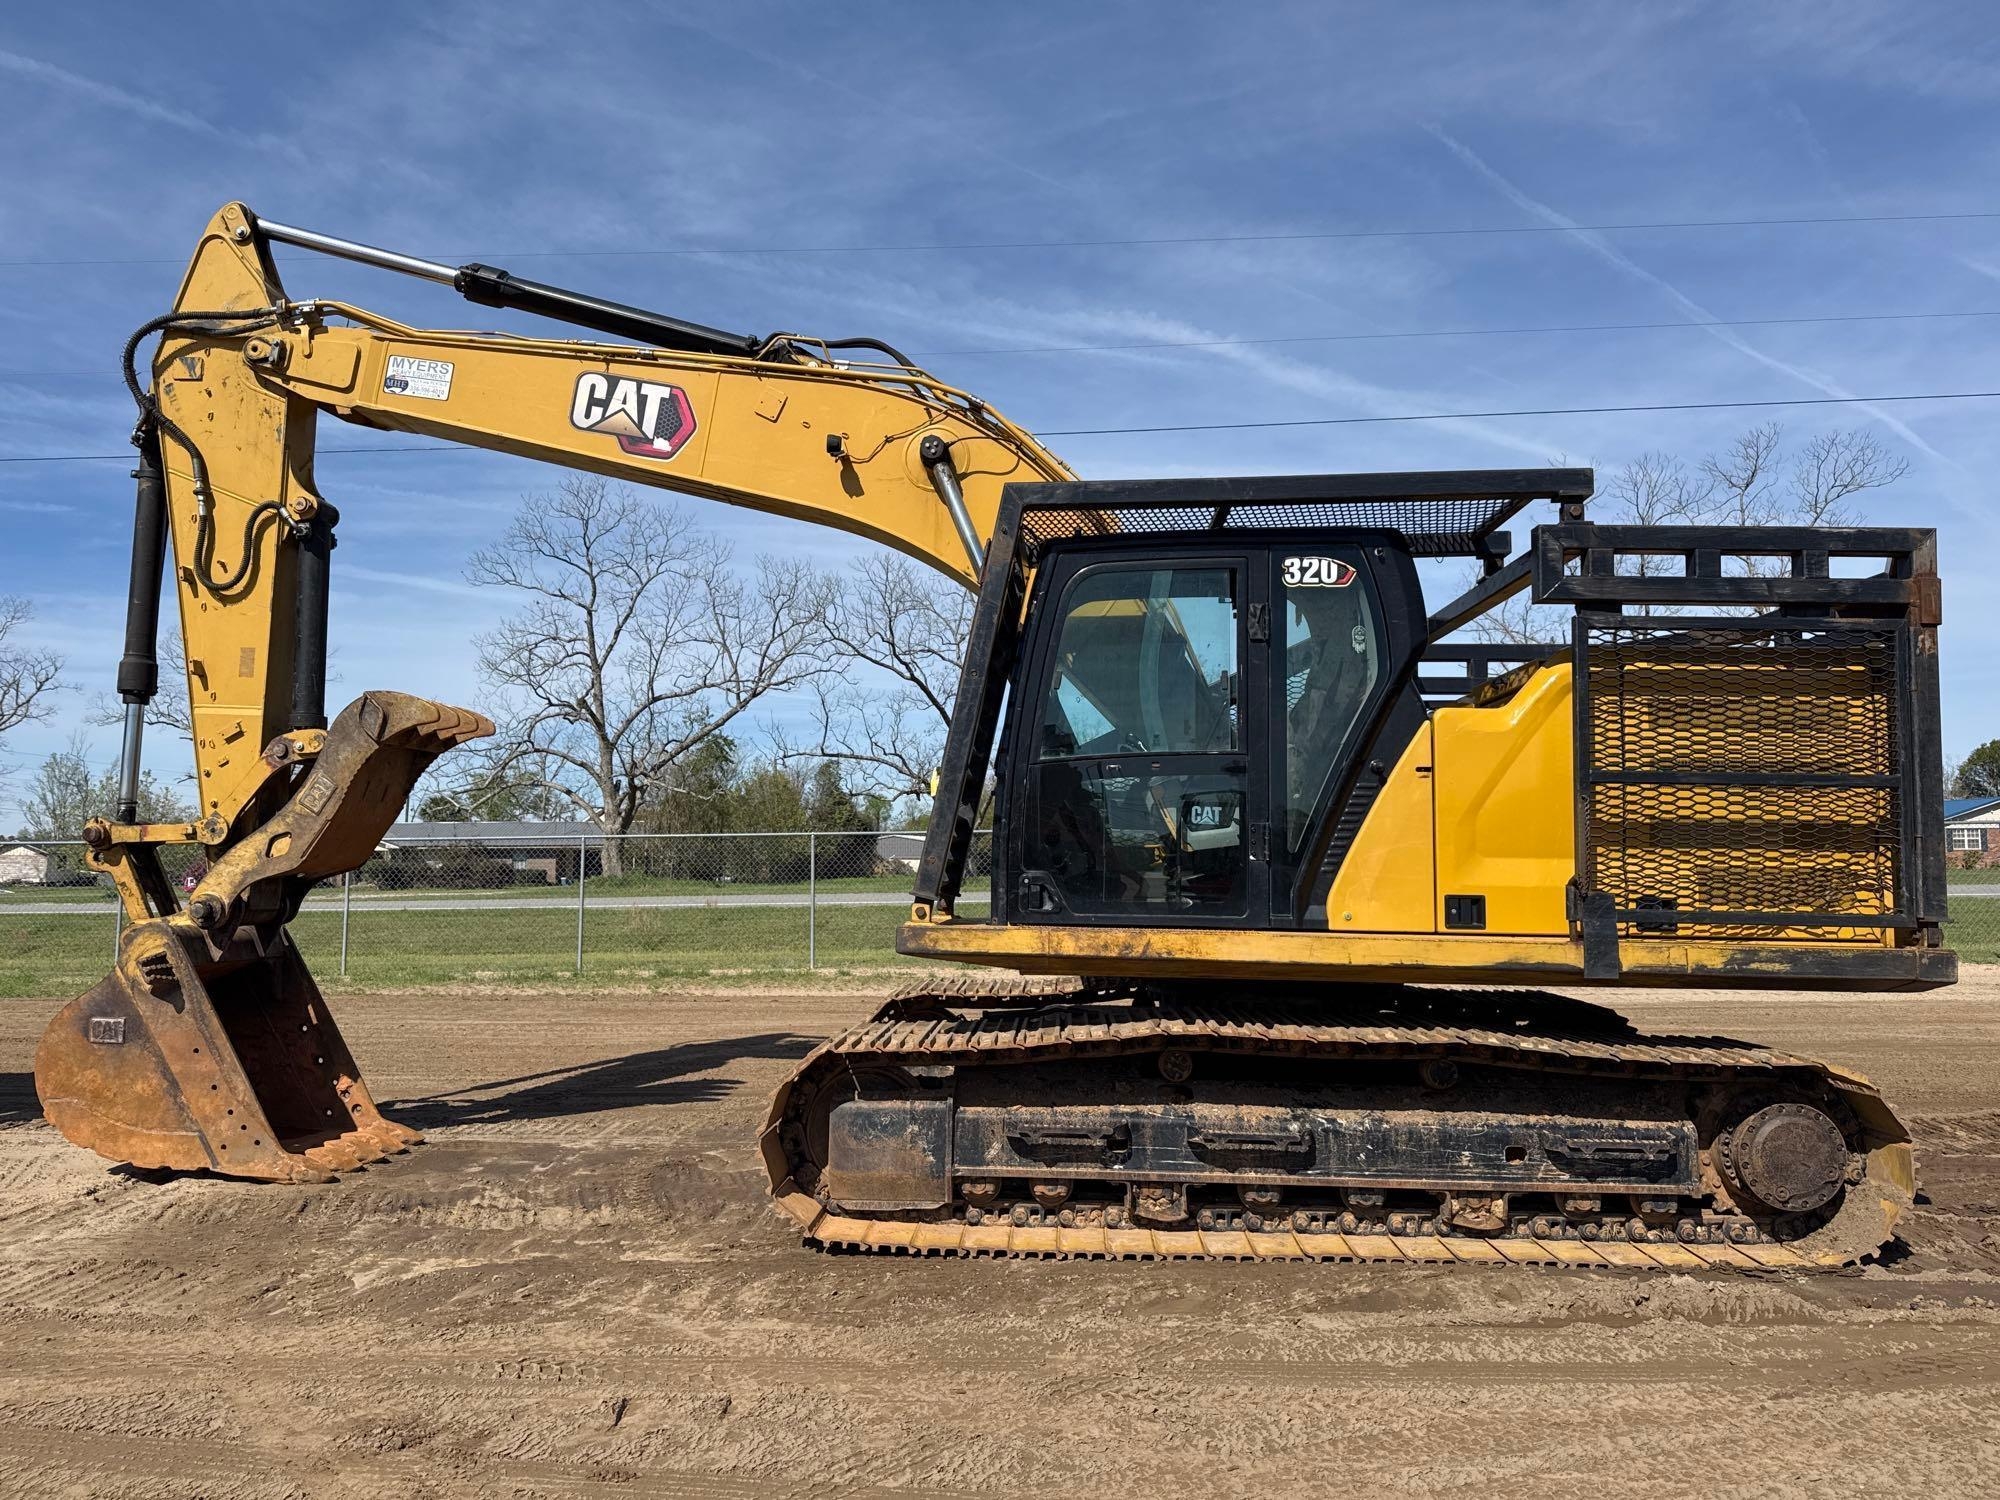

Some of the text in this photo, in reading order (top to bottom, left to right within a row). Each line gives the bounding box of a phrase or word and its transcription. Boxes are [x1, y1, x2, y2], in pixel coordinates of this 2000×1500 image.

[392, 357, 450, 375] MYERS
[392, 368, 447, 381] HEAVY EQUIPMENT
[386, 379, 408, 389] MHE
[572, 373, 671, 440] CAT
[1284, 557, 1338, 584] 320
[303, 778, 333, 810] CAT
[1191, 805, 1223, 825] CAT
[92, 1020, 124, 1040] CAT
